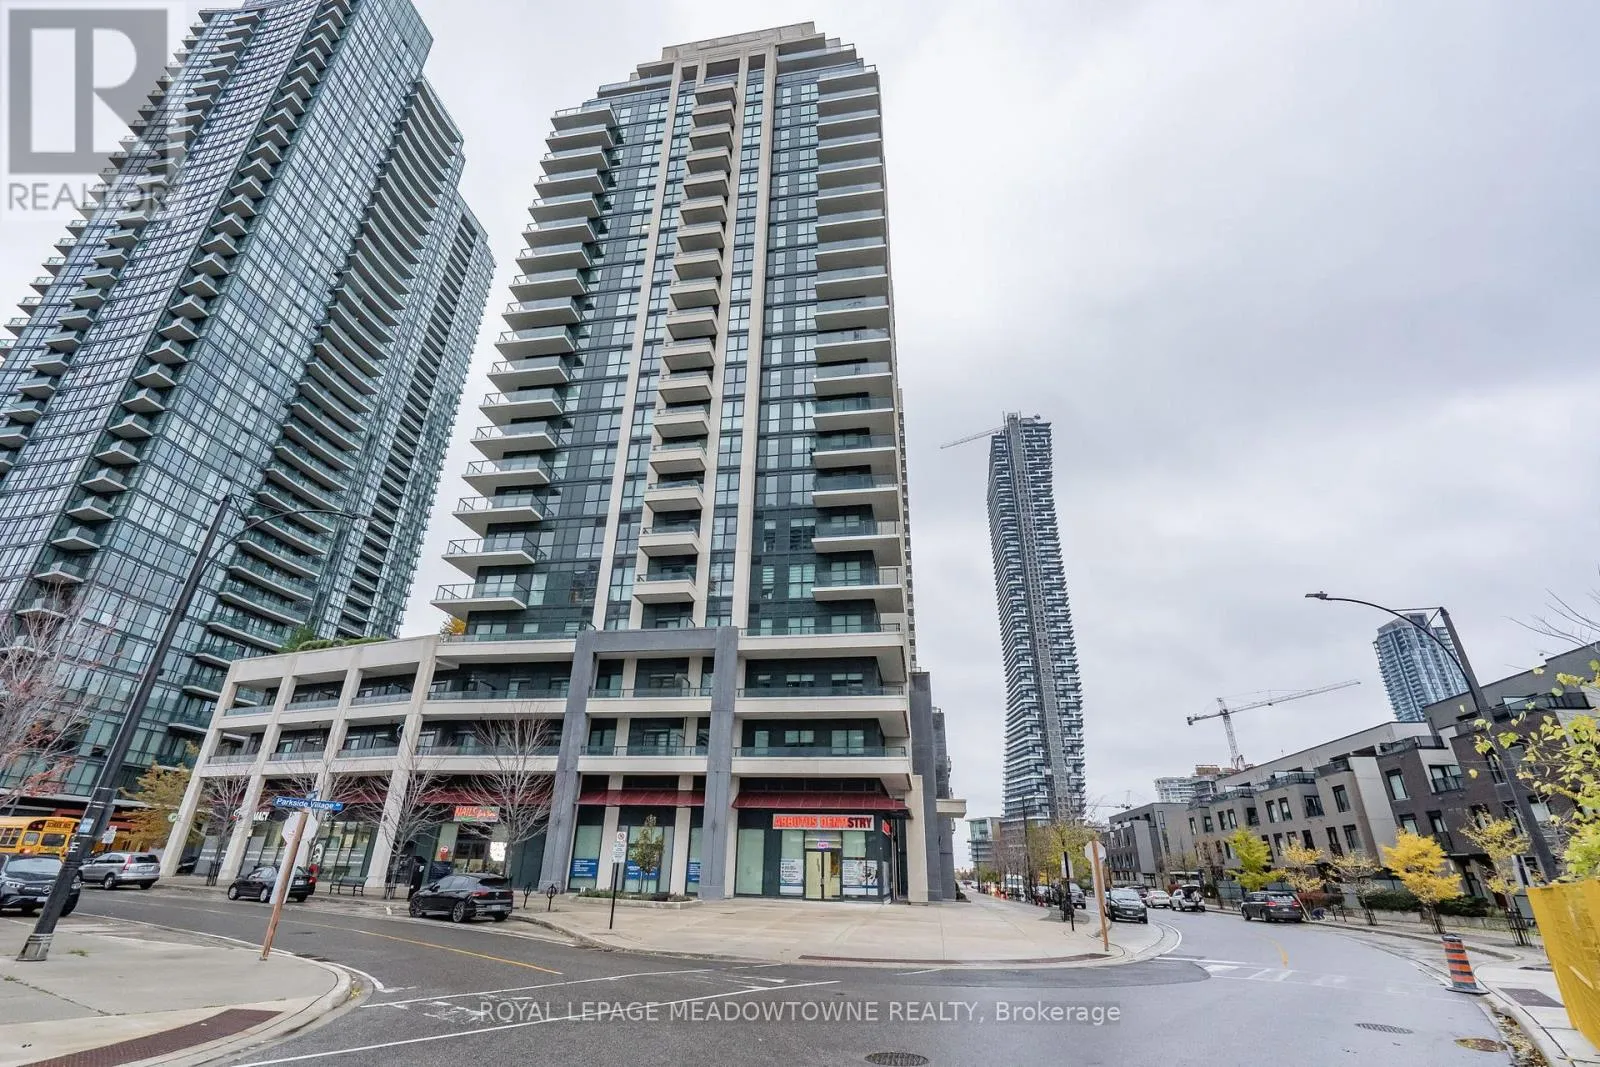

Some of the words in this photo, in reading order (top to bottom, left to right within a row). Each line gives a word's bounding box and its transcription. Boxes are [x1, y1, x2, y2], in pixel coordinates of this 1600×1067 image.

[276, 798, 308, 808] Parkside
[310, 800, 334, 810] Village
[455, 807, 478, 818] NAILS
[775, 816, 817, 828] ARBUTUS
[820, 817, 873, 829] DENTISTRY
